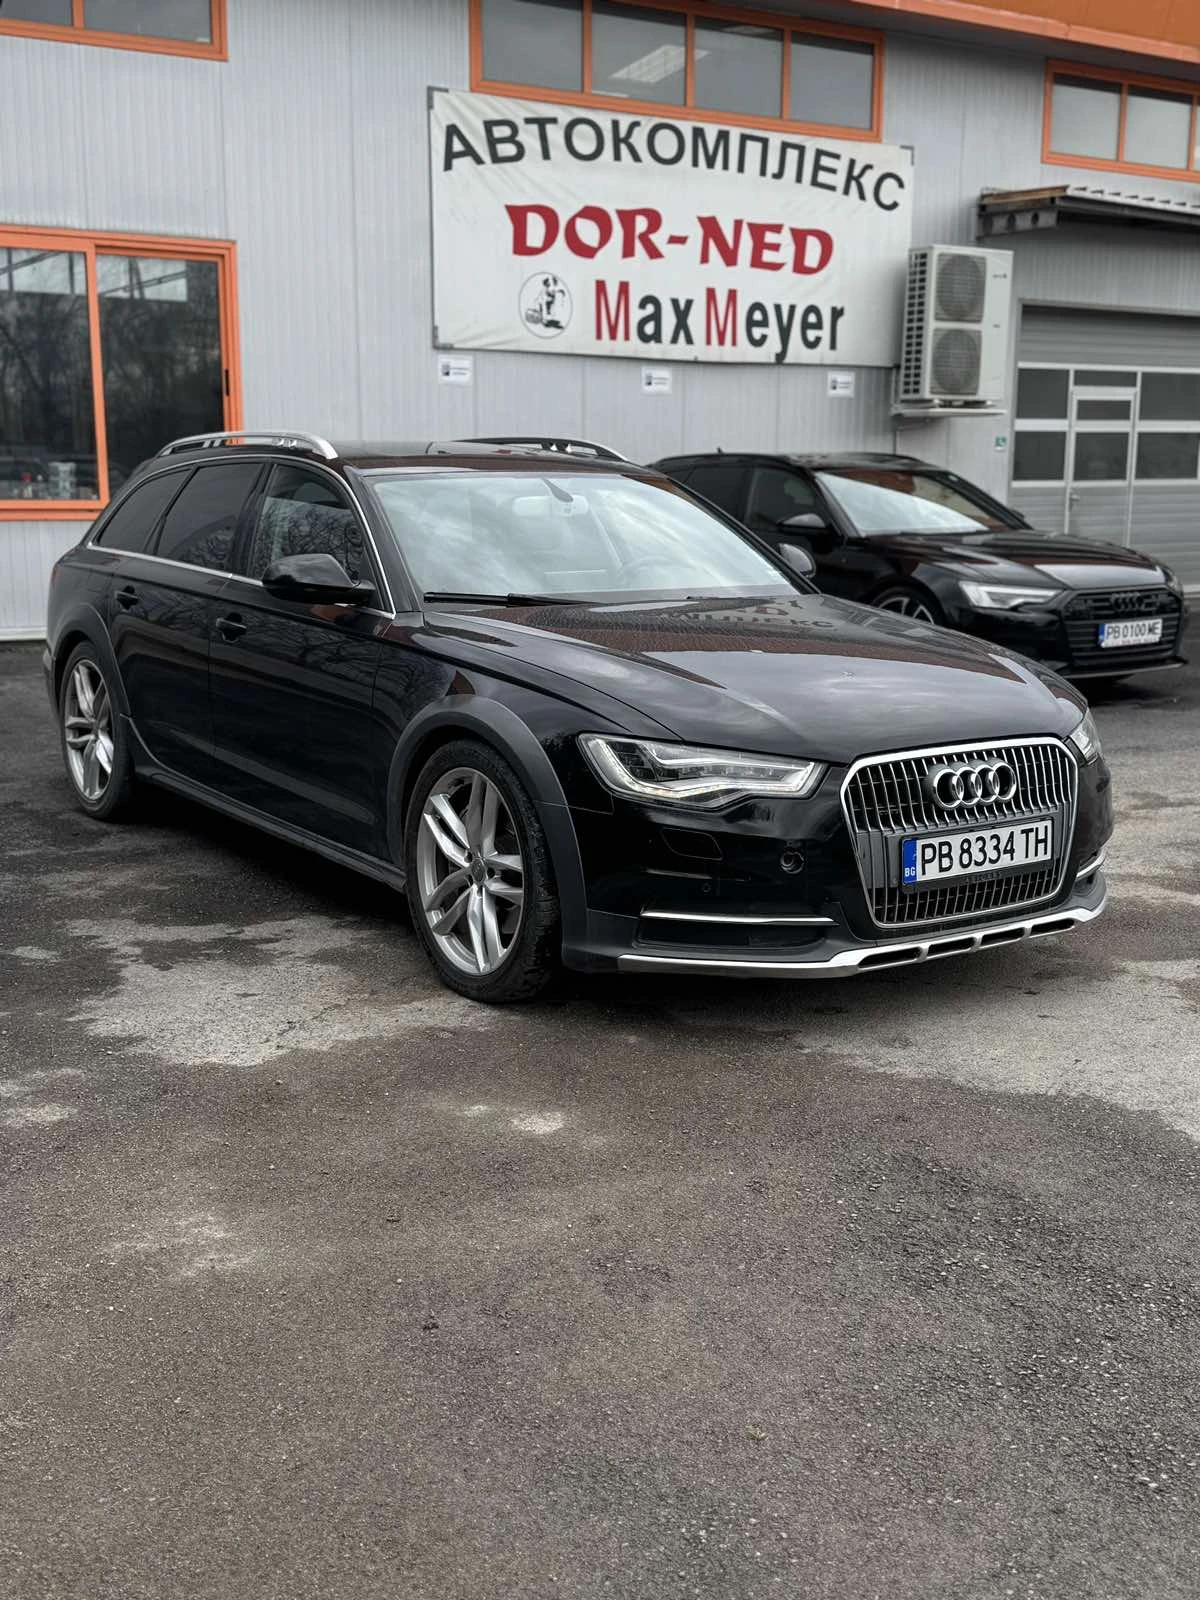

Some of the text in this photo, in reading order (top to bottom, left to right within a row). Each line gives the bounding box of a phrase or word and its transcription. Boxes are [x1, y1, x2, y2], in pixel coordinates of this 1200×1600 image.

[444, 117, 905, 211] АВТОКОМПЛЕКС
[504, 204, 834, 275] DOR-NED
[905, 867, 916, 877] BG
[921, 825, 1048, 876] PB 8334 TH
